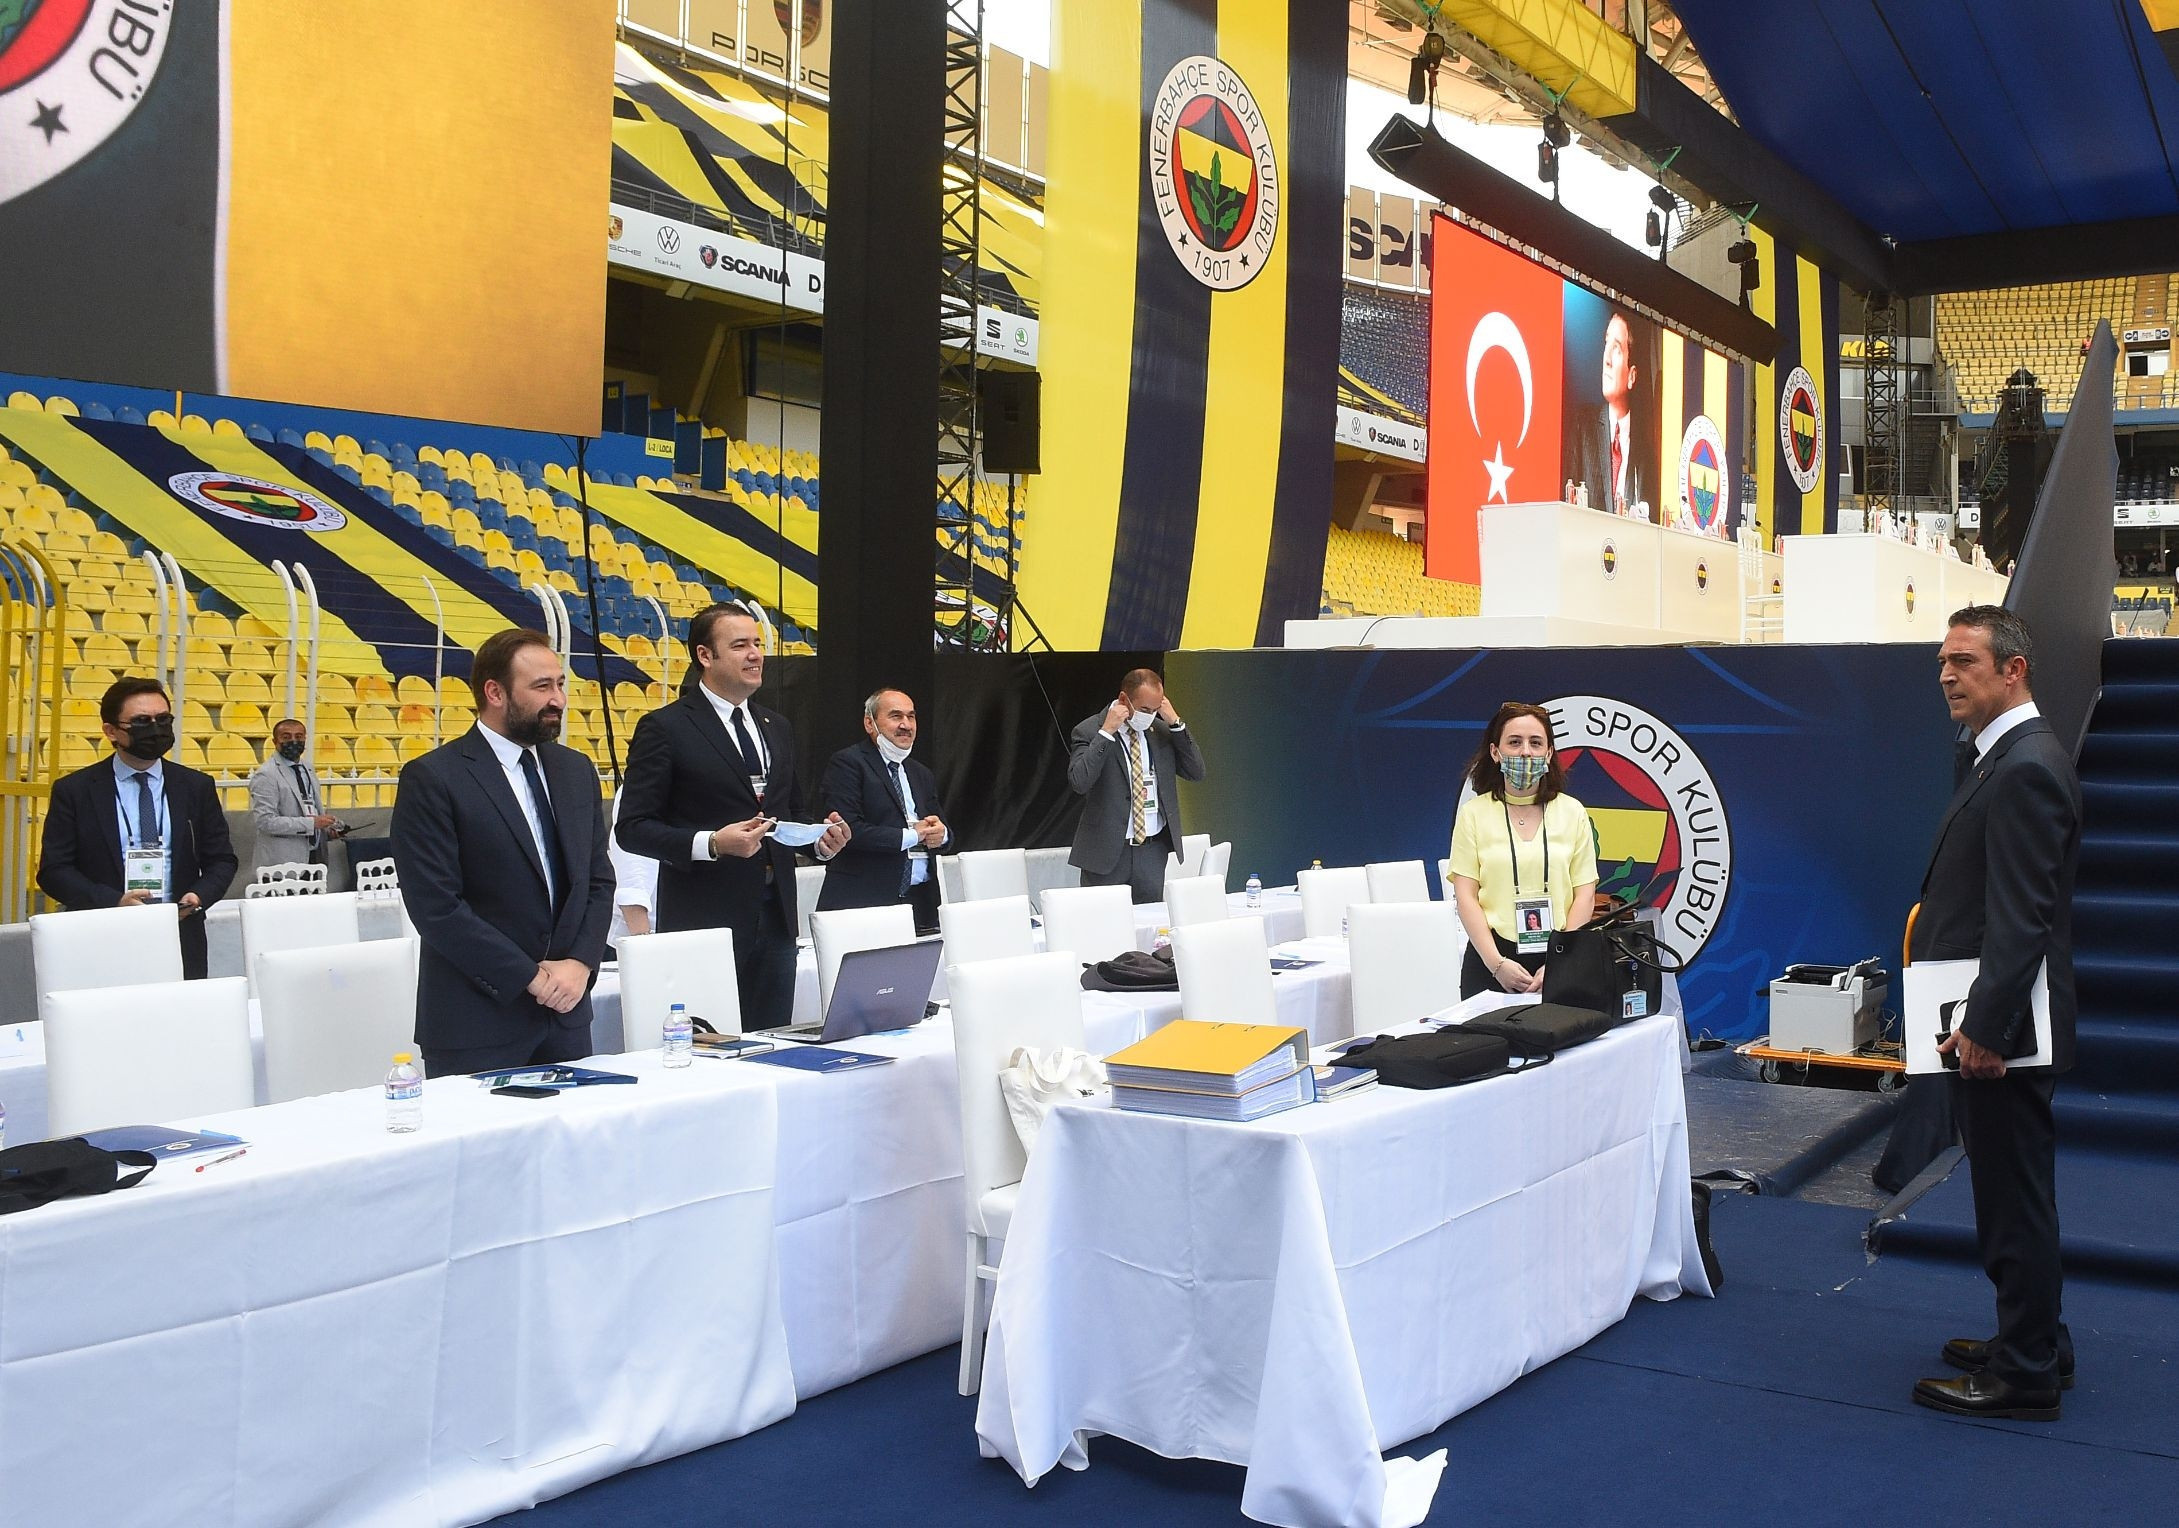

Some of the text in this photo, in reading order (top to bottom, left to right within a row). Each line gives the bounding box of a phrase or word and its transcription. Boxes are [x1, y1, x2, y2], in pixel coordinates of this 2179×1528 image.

[1154, 63, 1277, 254] FENERBAHÇE SPOR KULÜBÜ
[721, 255, 791, 287] SCANIA
[1193, 250, 1231, 282] 1907
[980, 339, 1006, 351] SEAT
[1377, 432, 1407, 449] SCANIA
[1585, 706, 1681, 776] SPOR
[1675, 779, 1727, 941] KULÜBÜ
